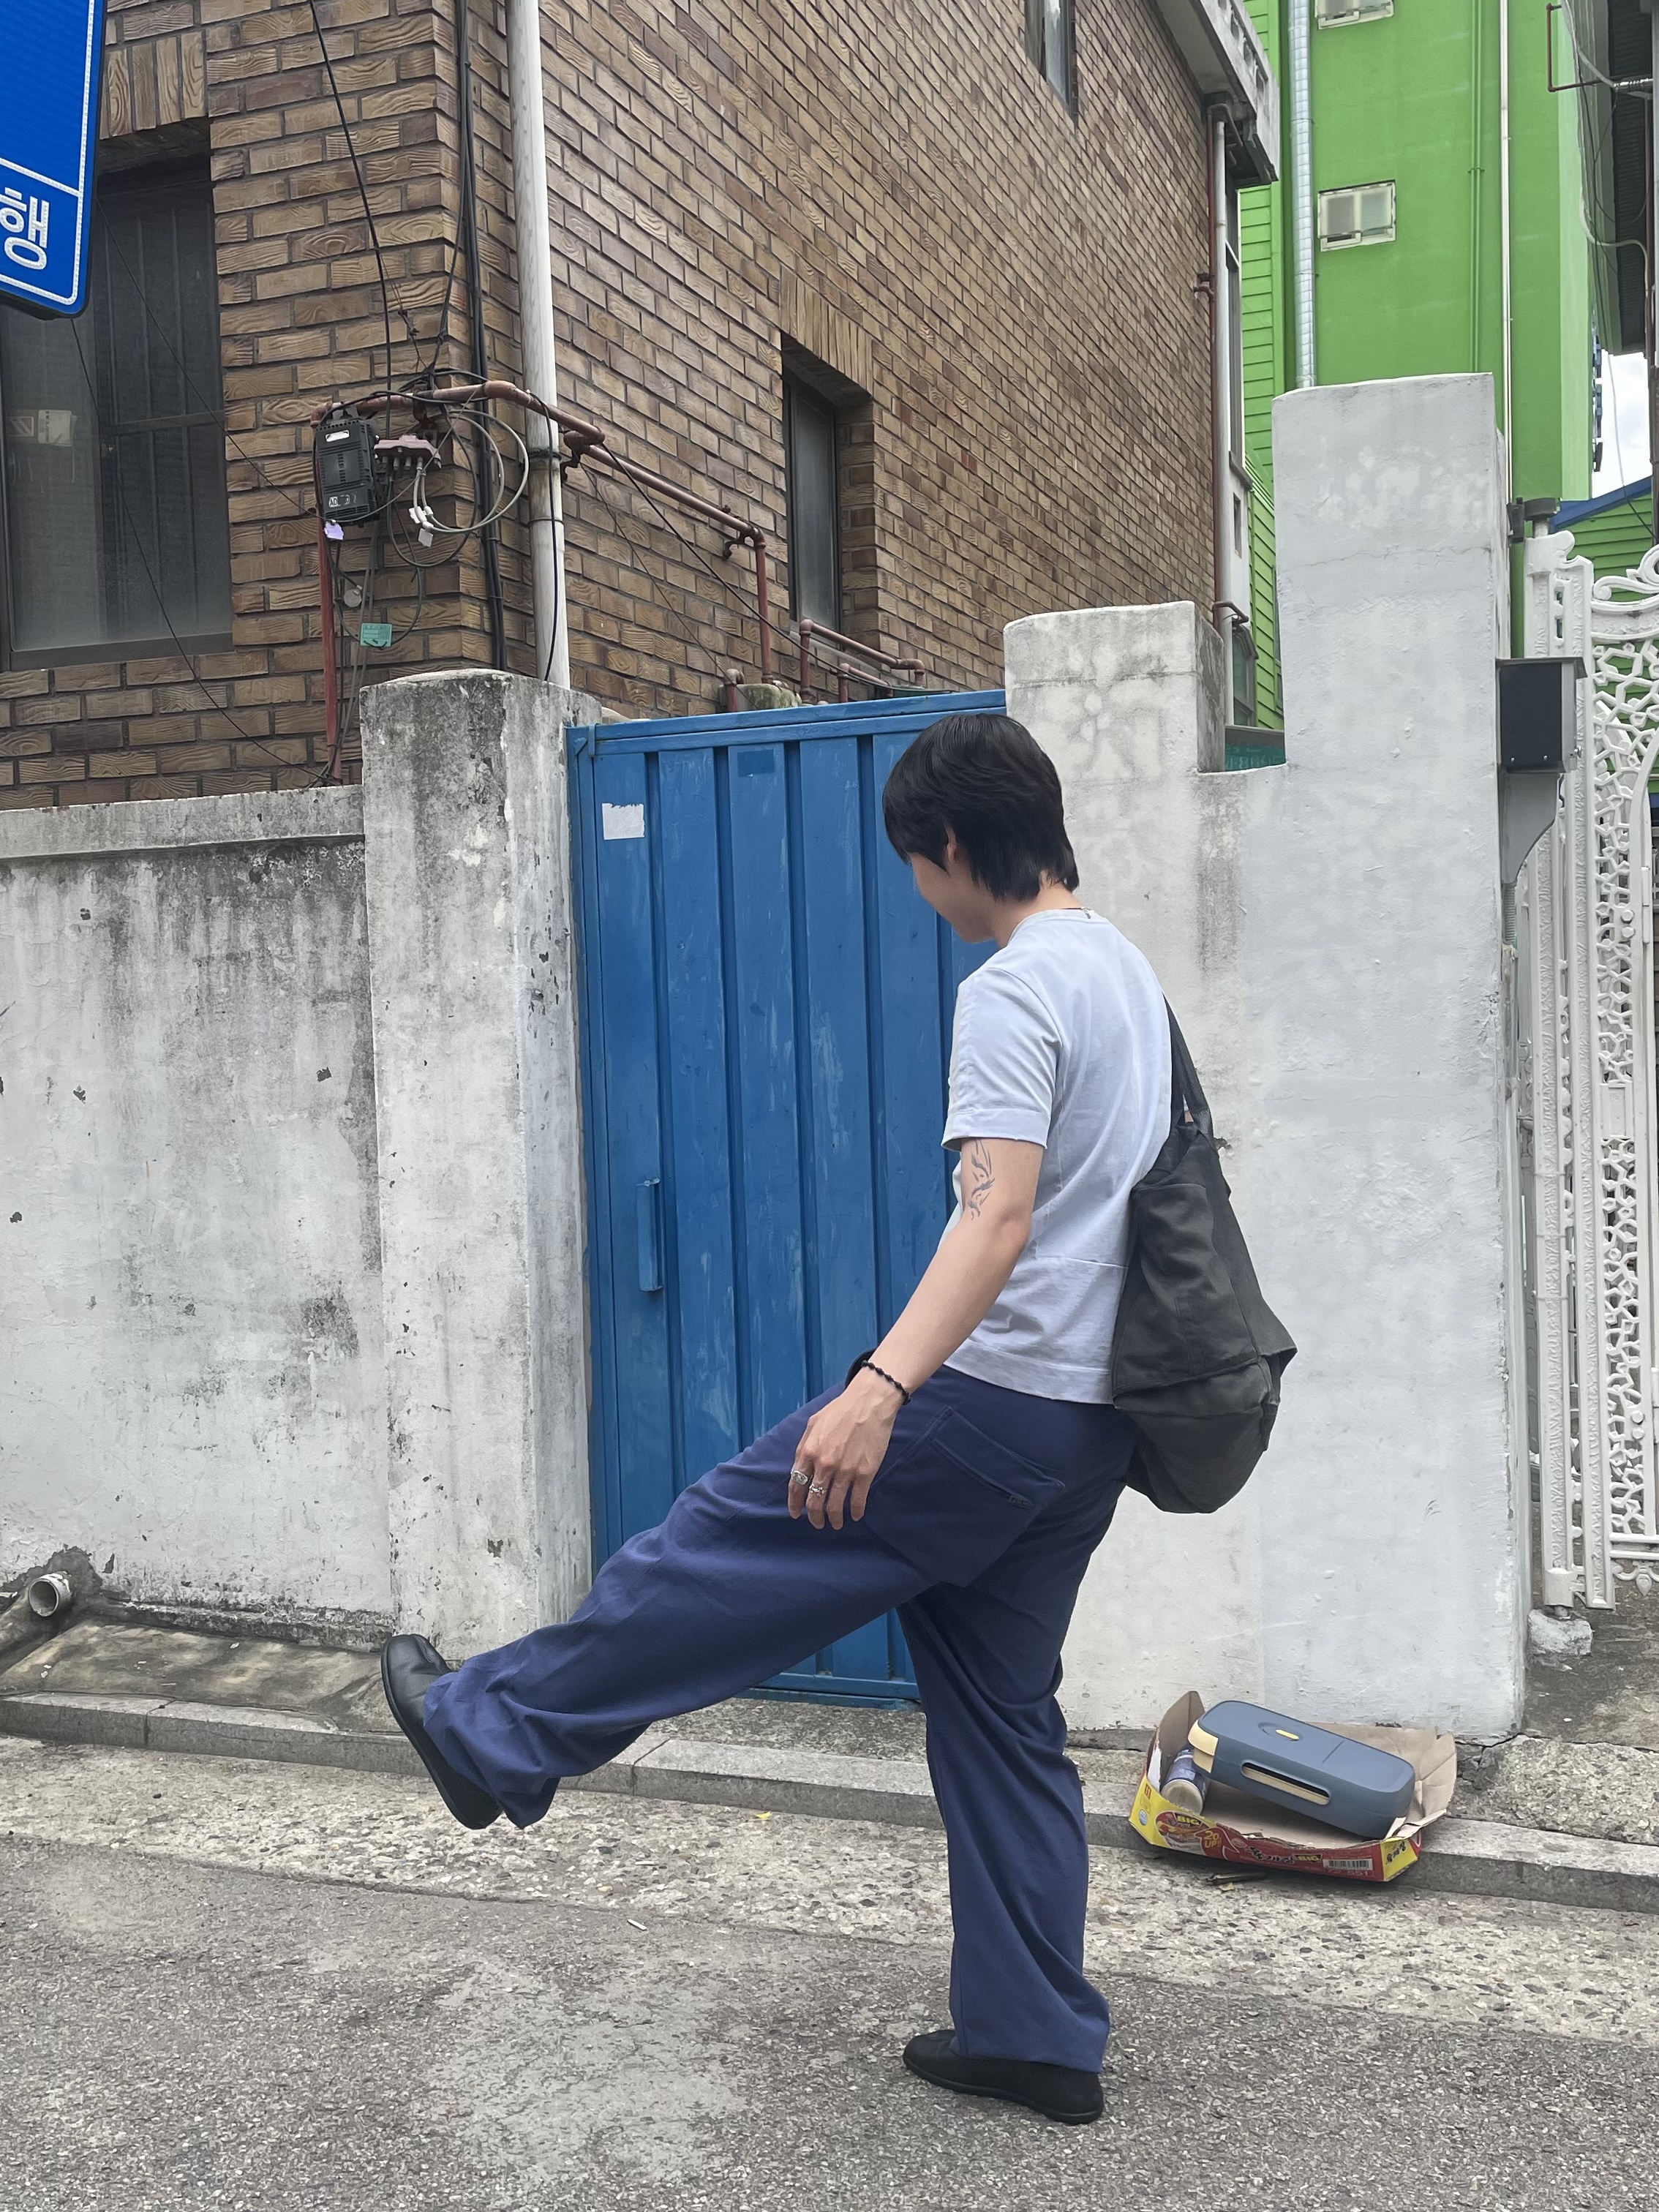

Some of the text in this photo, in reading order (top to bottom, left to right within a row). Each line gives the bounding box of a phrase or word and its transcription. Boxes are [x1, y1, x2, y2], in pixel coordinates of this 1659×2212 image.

[0, 187, 49, 271] 행
[1176, 1815, 1200, 1826] BIG
[1204, 1829, 1220, 1840] 20
